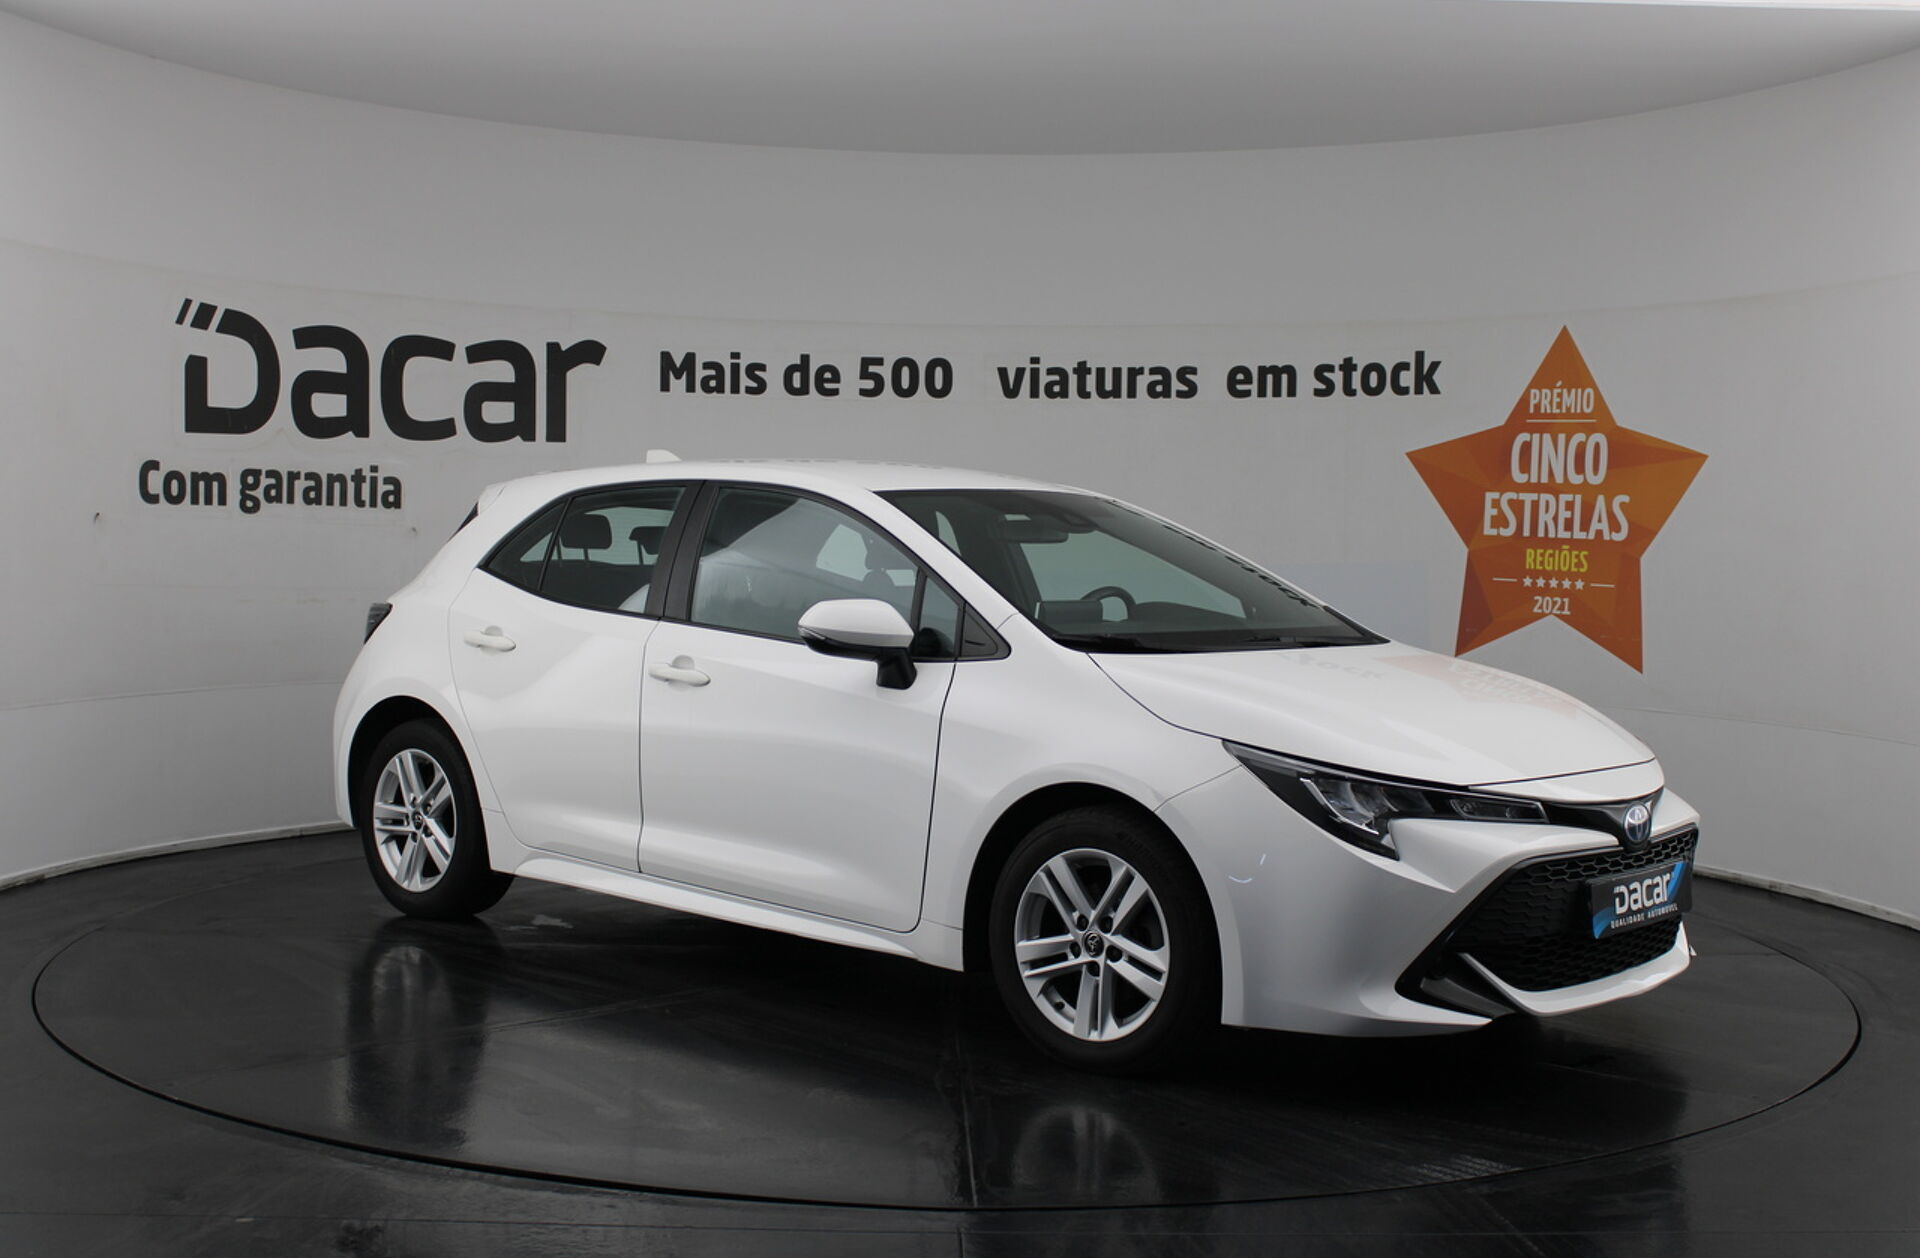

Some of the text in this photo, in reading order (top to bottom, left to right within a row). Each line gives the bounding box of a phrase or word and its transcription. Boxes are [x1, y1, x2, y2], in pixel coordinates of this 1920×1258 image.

[175, 297, 607, 443] Dacar
[659, 350, 1442, 400] Mais de 500 viaturas em stock
[1529, 380, 1595, 414] PRÉMIO
[1511, 432, 1609, 485] CINCO
[138, 459, 403, 515] Com garantia
[1483, 491, 1631, 542] ESTRELAS
[1525, 545, 1589, 573] REGIÕES
[1532, 596, 1571, 615] 2021
[1614, 873, 1671, 915] Dacar
